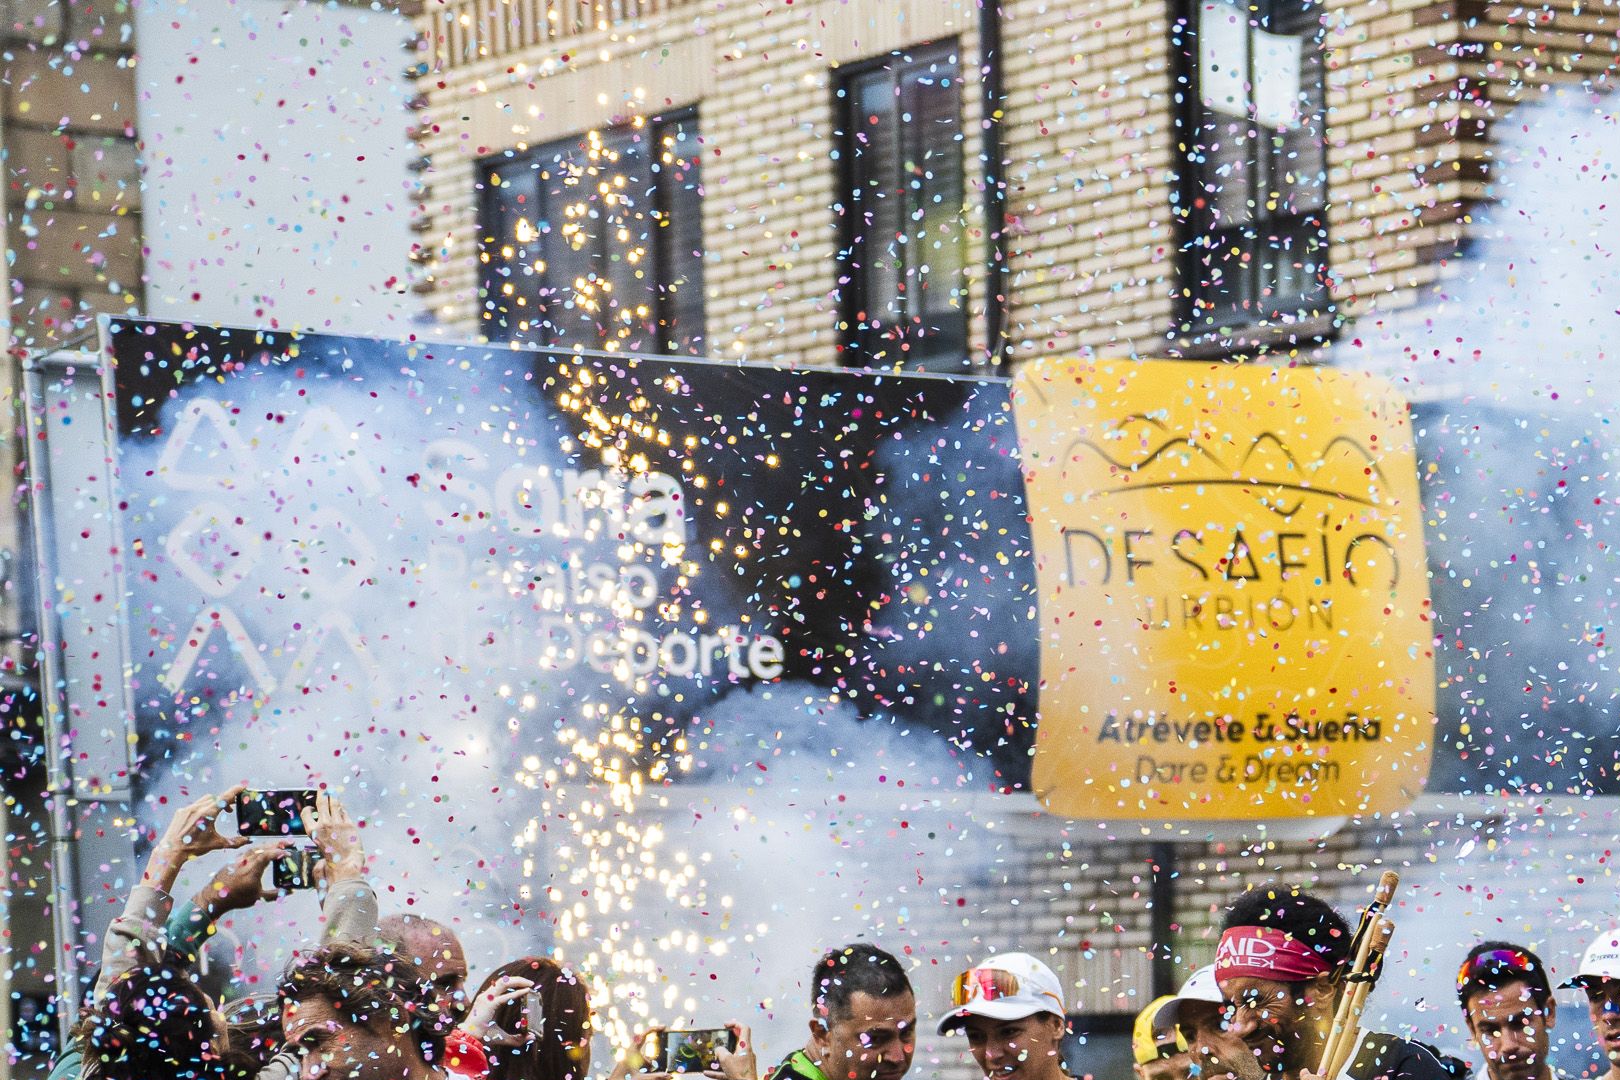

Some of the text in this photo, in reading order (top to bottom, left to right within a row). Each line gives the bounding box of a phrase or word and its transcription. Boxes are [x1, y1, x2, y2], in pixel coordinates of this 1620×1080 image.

[541, 616, 785, 691] Deporte
[1098, 712, 1246, 744] Atrévete
[1282, 712, 1383, 744] Sueña
[1134, 755, 1208, 785] Dare
[1243, 755, 1341, 785] Dream
